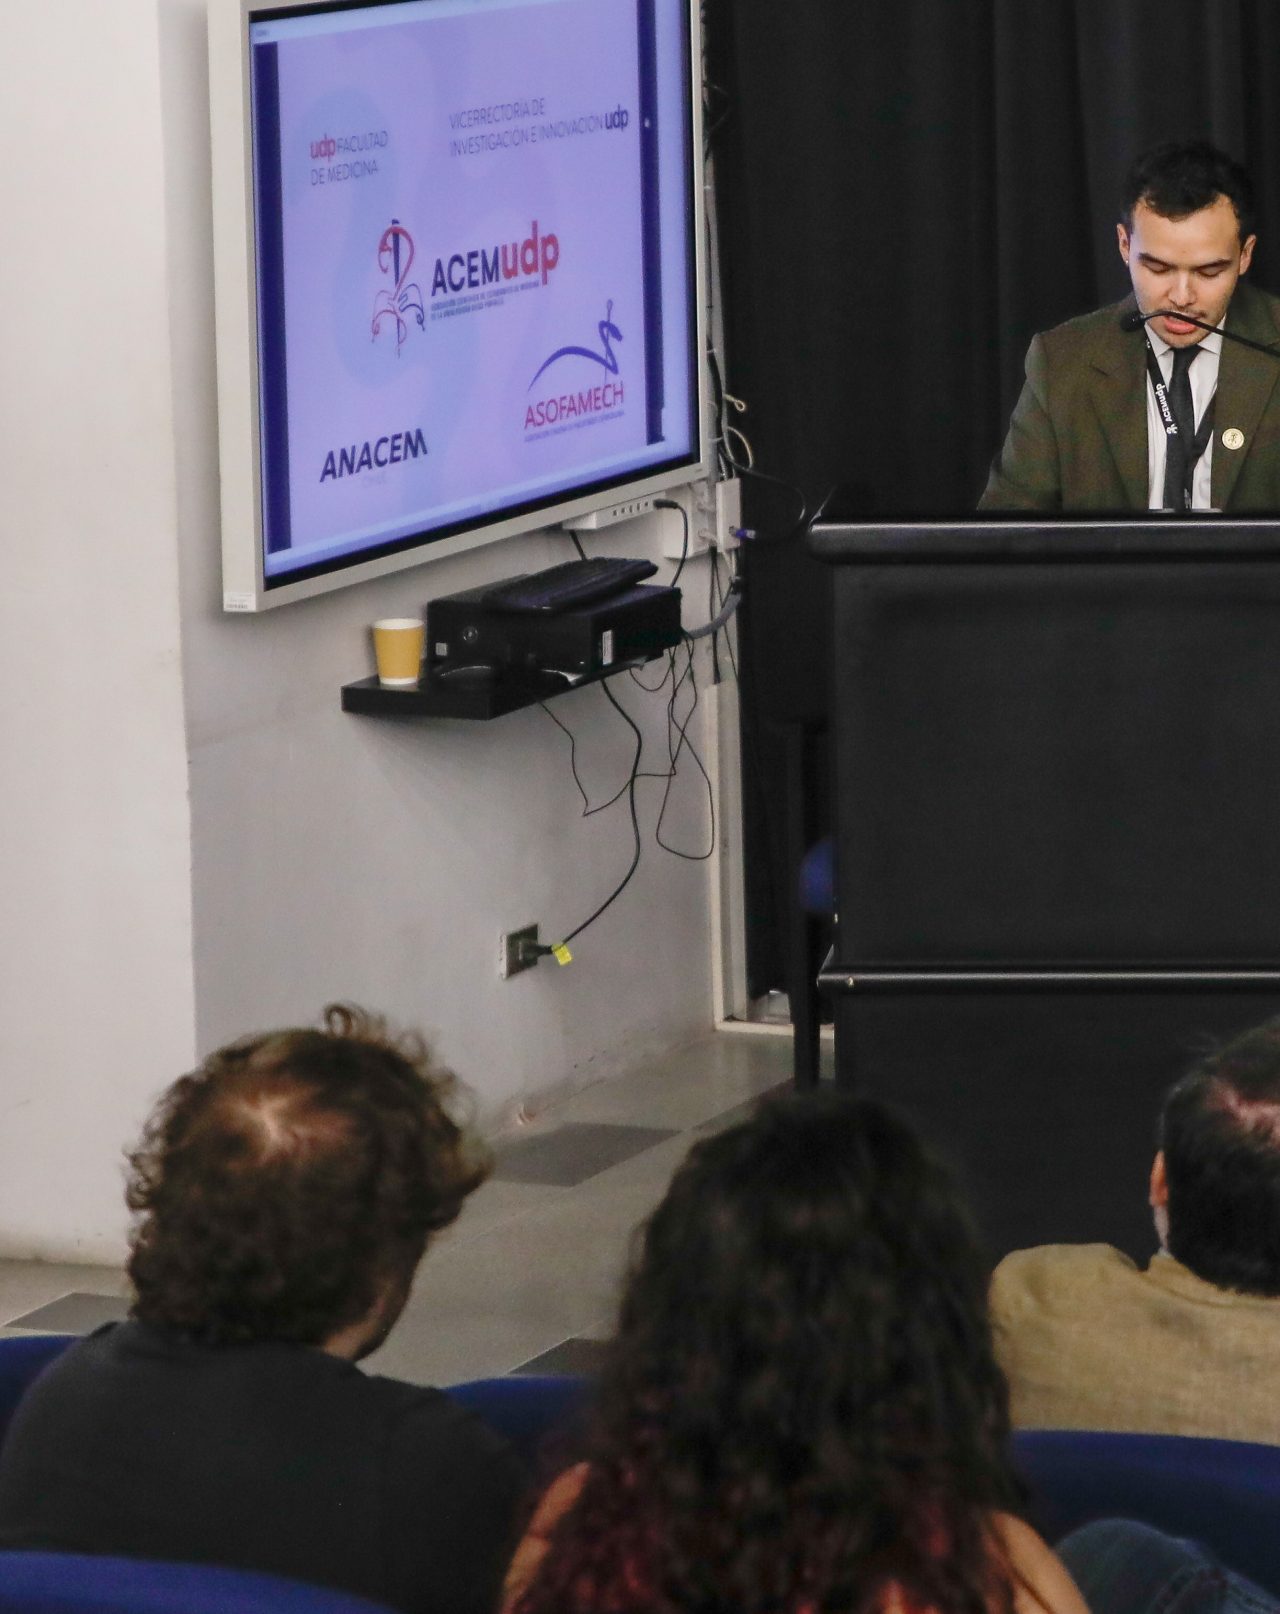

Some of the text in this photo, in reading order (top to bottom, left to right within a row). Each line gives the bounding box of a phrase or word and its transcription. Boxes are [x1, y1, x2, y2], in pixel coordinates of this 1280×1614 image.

[605, 104, 629, 132] udp
[337, 130, 389, 153] FACULTAD
[311, 159, 379, 186] DE MEDICINA
[524, 381, 624, 430] ASOFAMECH
[319, 428, 428, 482] ANACEM
